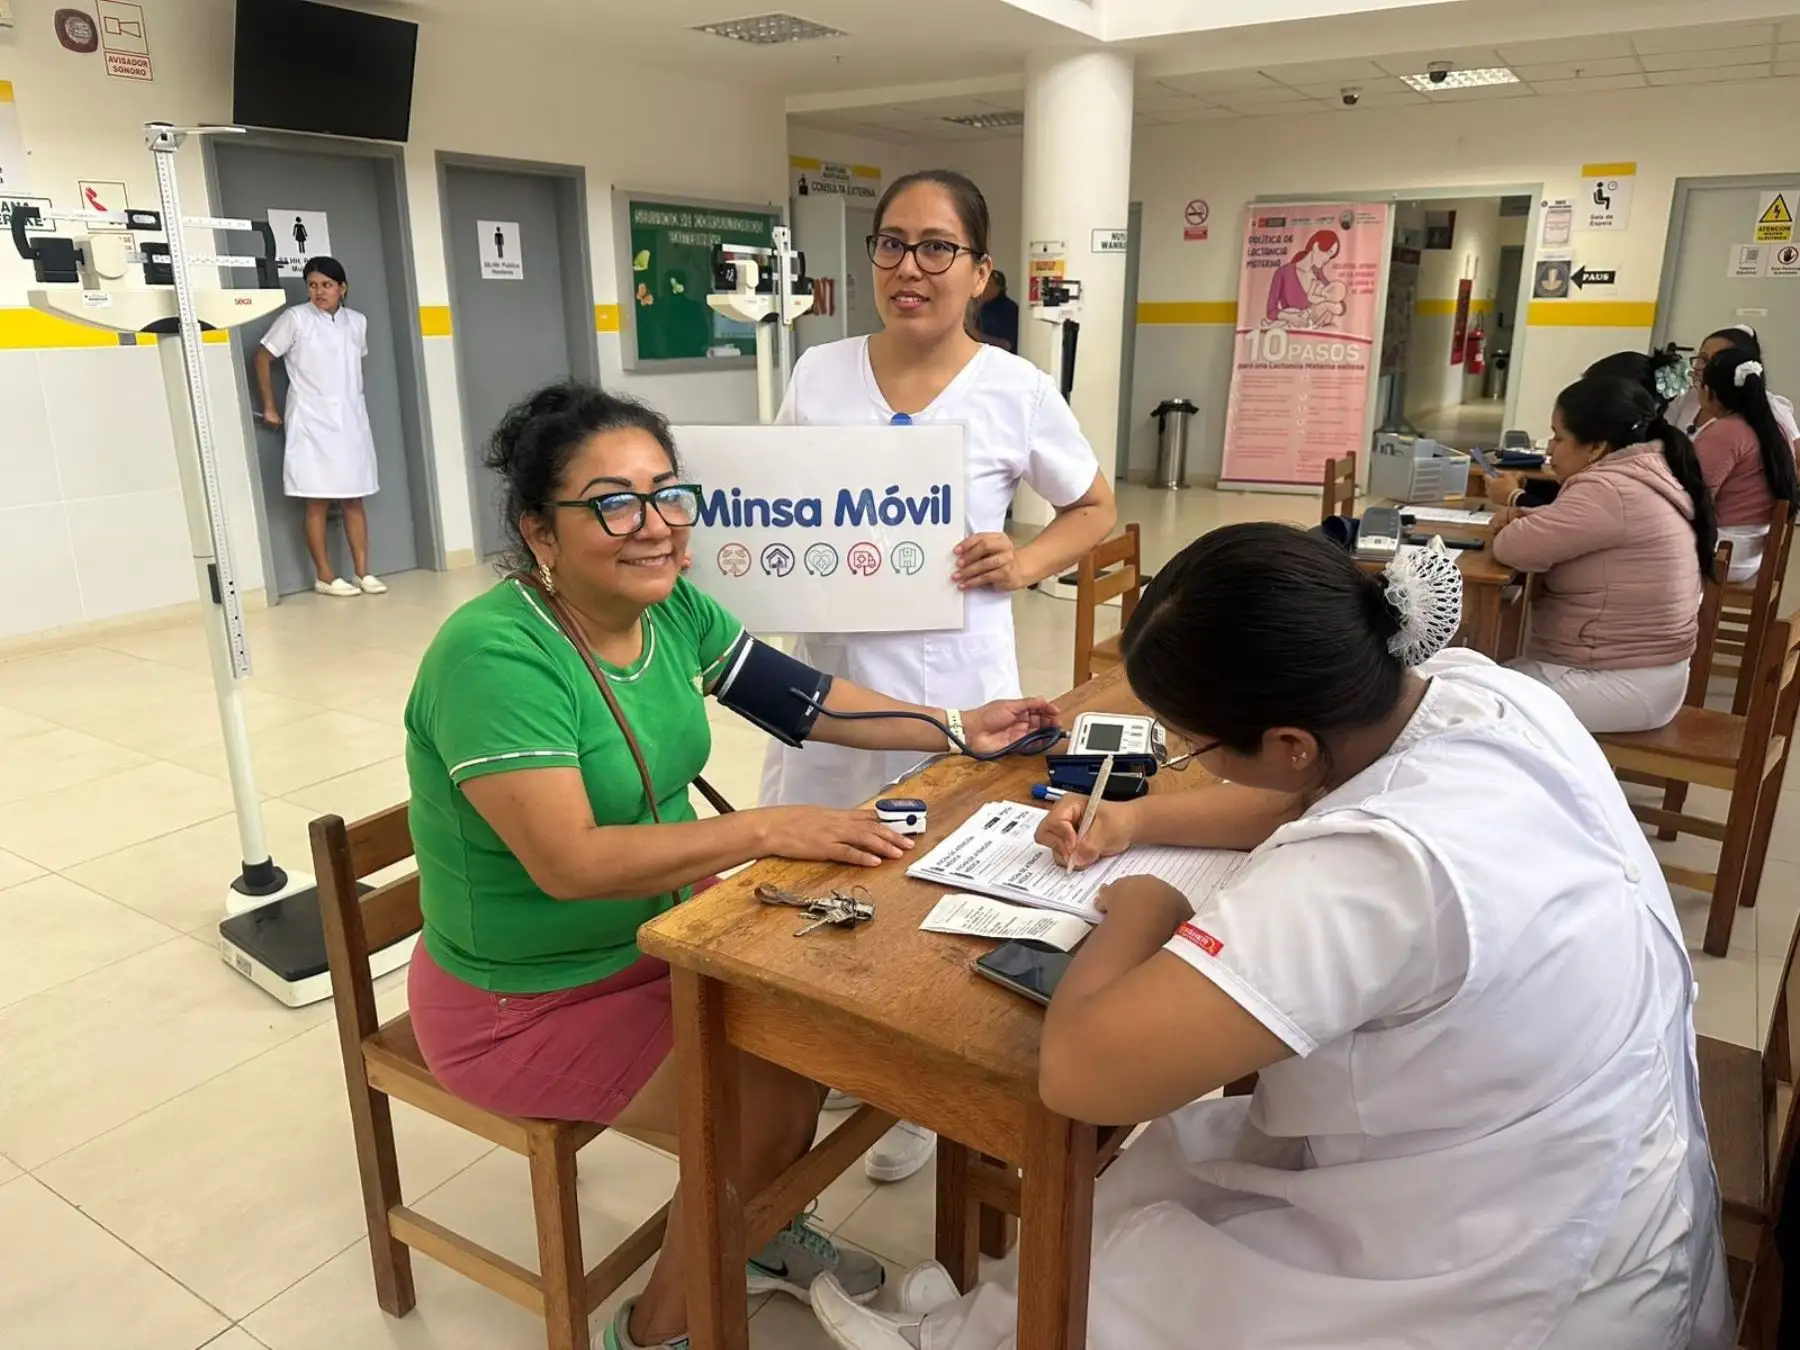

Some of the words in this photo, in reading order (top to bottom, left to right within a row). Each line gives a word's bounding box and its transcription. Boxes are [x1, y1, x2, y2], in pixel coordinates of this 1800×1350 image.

[108, 56, 148, 68] AVISADOR
[112, 65, 147, 77] SONORO
[1582, 273, 1609, 281] PAUS
[1245, 328, 1288, 362] 10
[1288, 344, 1361, 361] PASOS
[699, 486, 822, 528] Minsa
[834, 483, 951, 527] Móvil
